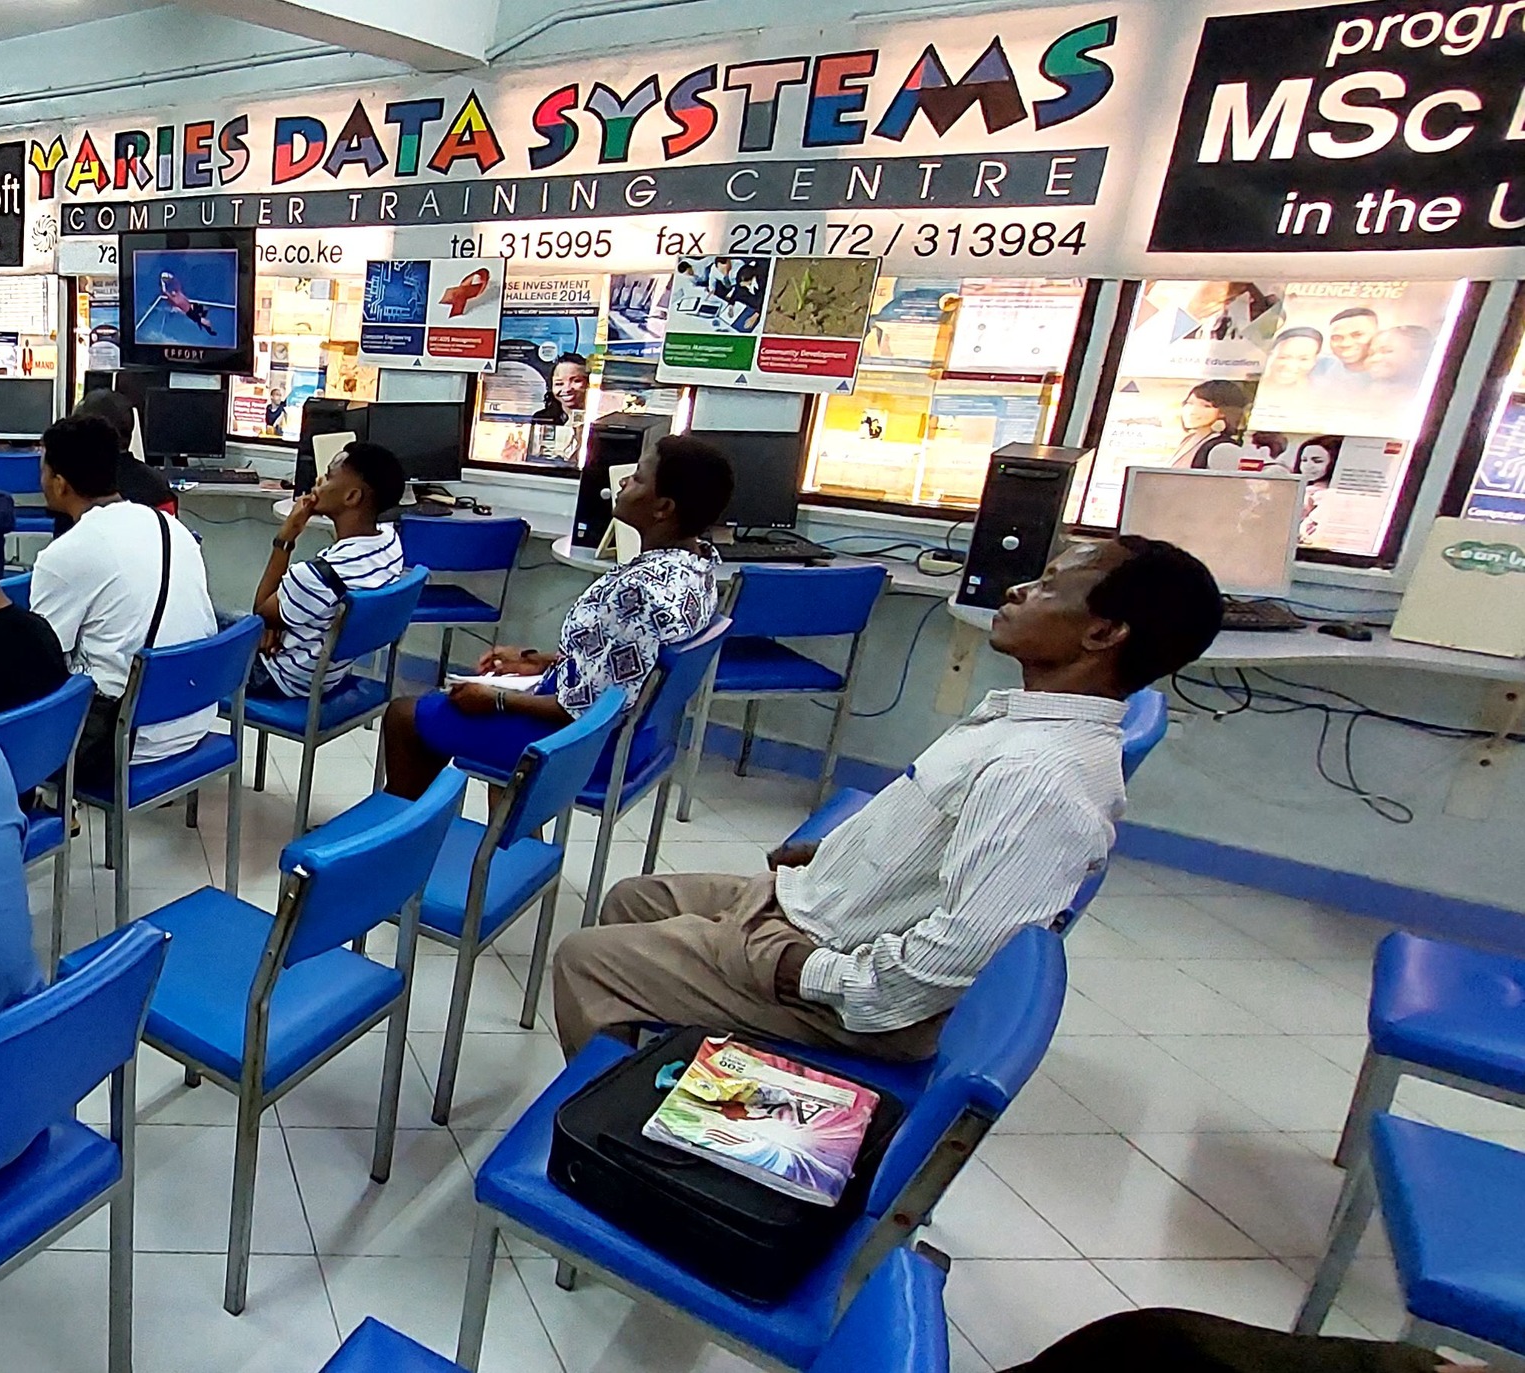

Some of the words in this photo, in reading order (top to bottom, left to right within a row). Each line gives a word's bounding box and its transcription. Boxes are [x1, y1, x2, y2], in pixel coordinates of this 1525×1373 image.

[1325, 1, 1525, 68] progr
[29, 114, 249, 200] YARIES
[272, 88, 505, 186] DATA
[528, 16, 1118, 170] SYSTEMS
[1197, 71, 1482, 163] MSc
[69, 197, 304, 230] COMPUTER
[348, 174, 657, 222] TRAINING
[725, 156, 1077, 201] CENTRE
[1277, 191, 1332, 235] in
[1355, 189, 1461, 234] the
[451, 232, 483, 258] tel
[499, 228, 612, 260] 315995
[655, 225, 706, 256] fax
[729, 224, 875, 256] 228172
[883, 222, 904, 256] /
[913, 220, 1088, 257] 313984
[506, 291, 558, 300] HALLENGE
[559, 289, 591, 302] 2014
[522, 279, 590, 290] INVESTMENT
[164, 348, 204, 360] EFFORT
[760, 347, 799, 357] Community
[800, 349, 848, 360] Development
[1205, 357, 1260, 366] Education
[718, 1060, 745, 1074] 200
